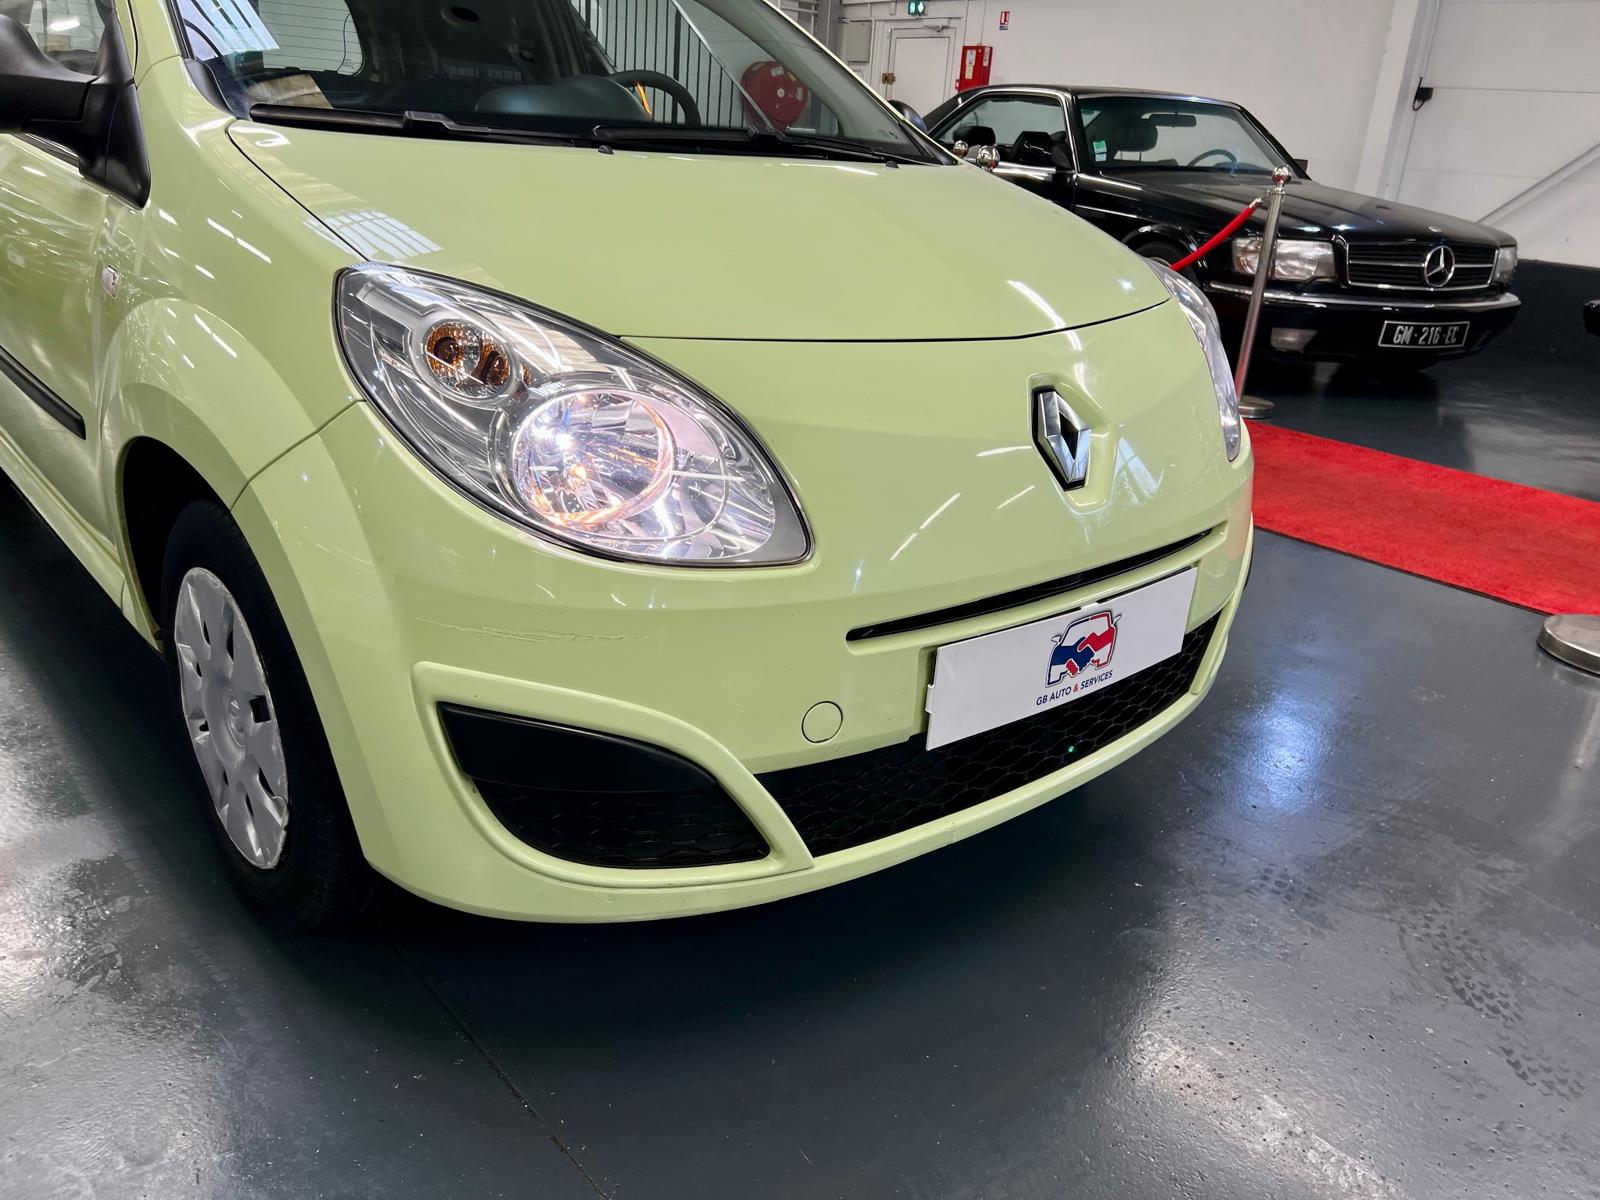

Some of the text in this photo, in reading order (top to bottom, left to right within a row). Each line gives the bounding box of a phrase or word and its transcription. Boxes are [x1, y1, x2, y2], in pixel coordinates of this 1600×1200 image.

[1036, 670, 1113, 705] GB AUTO & SERVICES
